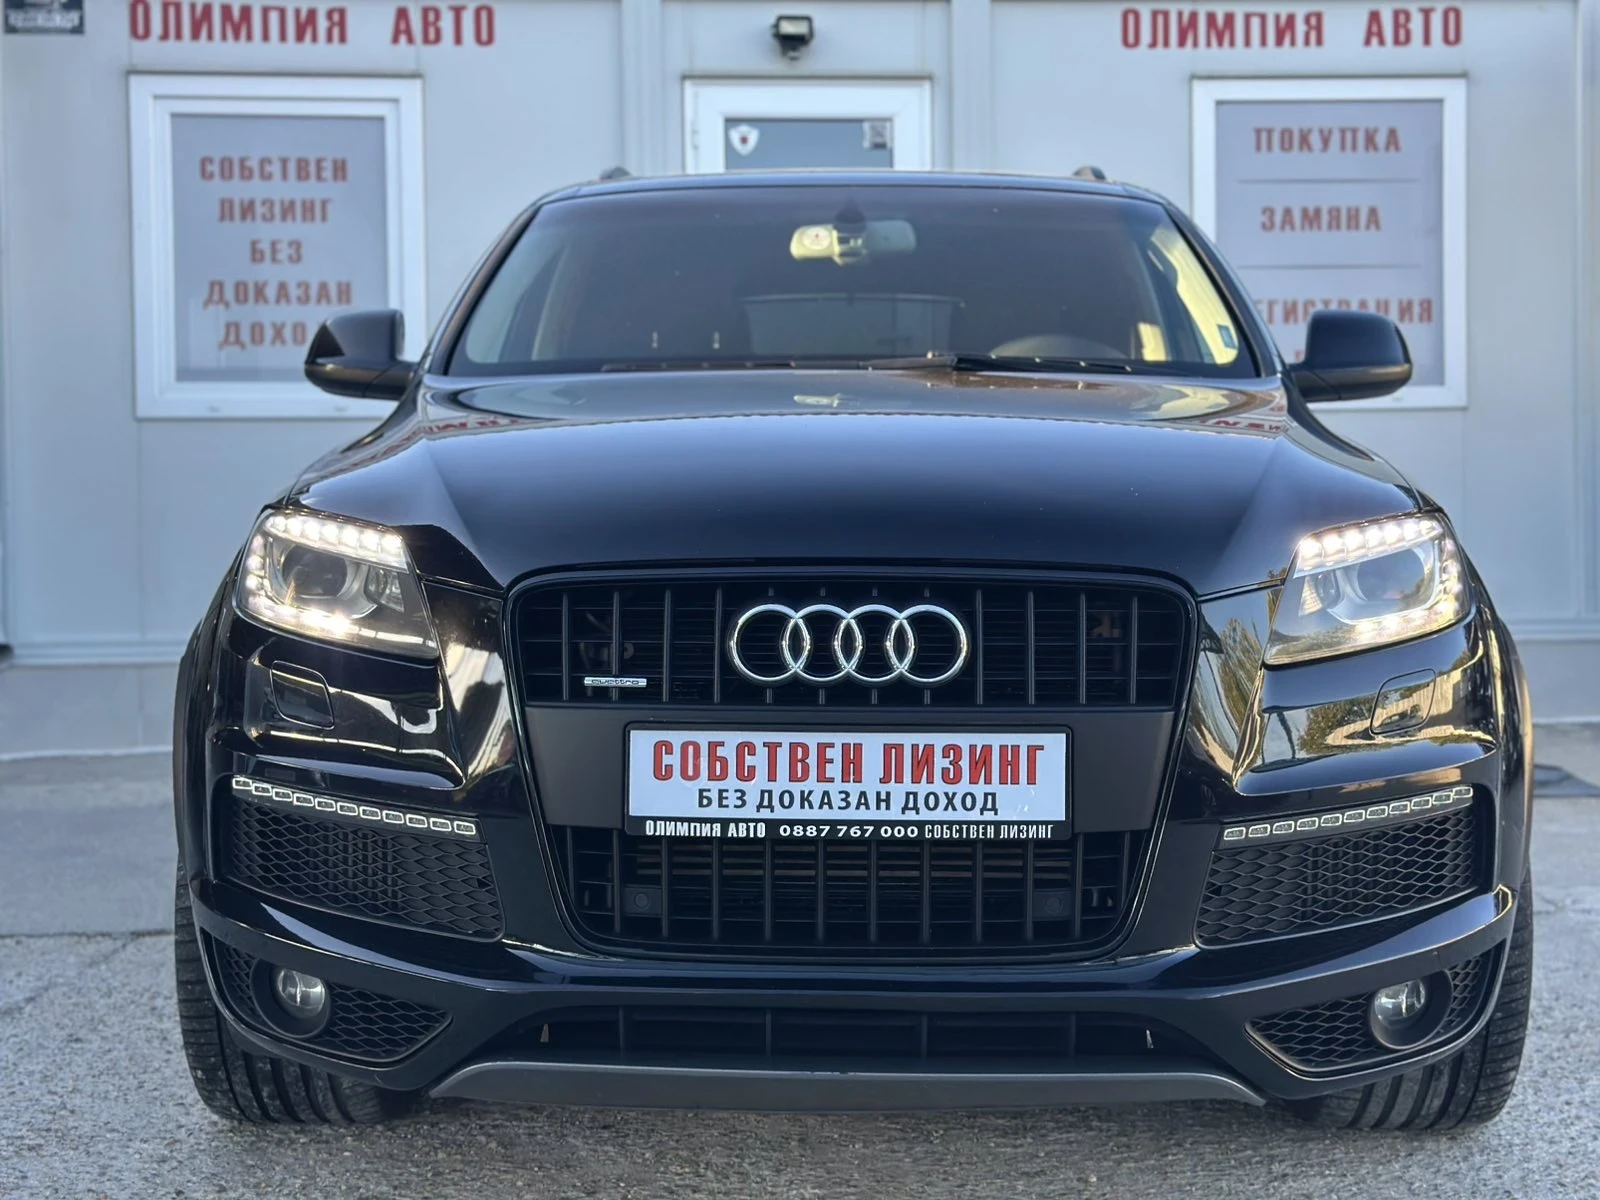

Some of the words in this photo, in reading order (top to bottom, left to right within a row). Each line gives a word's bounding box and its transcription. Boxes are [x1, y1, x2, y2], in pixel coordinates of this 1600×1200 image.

[129, 0, 349, 44] ОЛИМПИЯ
[390, 2, 496, 46] АВТО
[1121, 8, 1325, 49] ОЛИМПИЯ
[1363, 6, 1463, 47] АВТО
[1253, 126, 1402, 154] ПОКУПКА
[199, 156, 349, 183] СОБСТВЕН
[217, 198, 334, 224] ЛИЗИНГ
[1260, 206, 1382, 233] ЗАМЯНА
[249, 240, 304, 265] БЕЗ
[203, 280, 352, 310] ДОКАЗАН
[219, 321, 307, 351] ДОХО
[653, 740, 863, 783] СОБСТВЕН
[879, 743, 1045, 785] ЛИЗИНГ
[698, 788, 747, 809] БЕЗ
[756, 789, 891, 813] ДОКАЗАН
[901, 791, 999, 816] ДОХОД
[645, 820, 721, 837] ОЛИМПИЯ
[727, 822, 766, 838] АВТО
[779, 825, 830, 837] 0887
[836, 825, 875, 838] 767
[880, 825, 919, 838] 000
[924, 824, 995, 839] СОБСТВЕН
[999, 824, 1054, 839] ЛИЗИНГ
